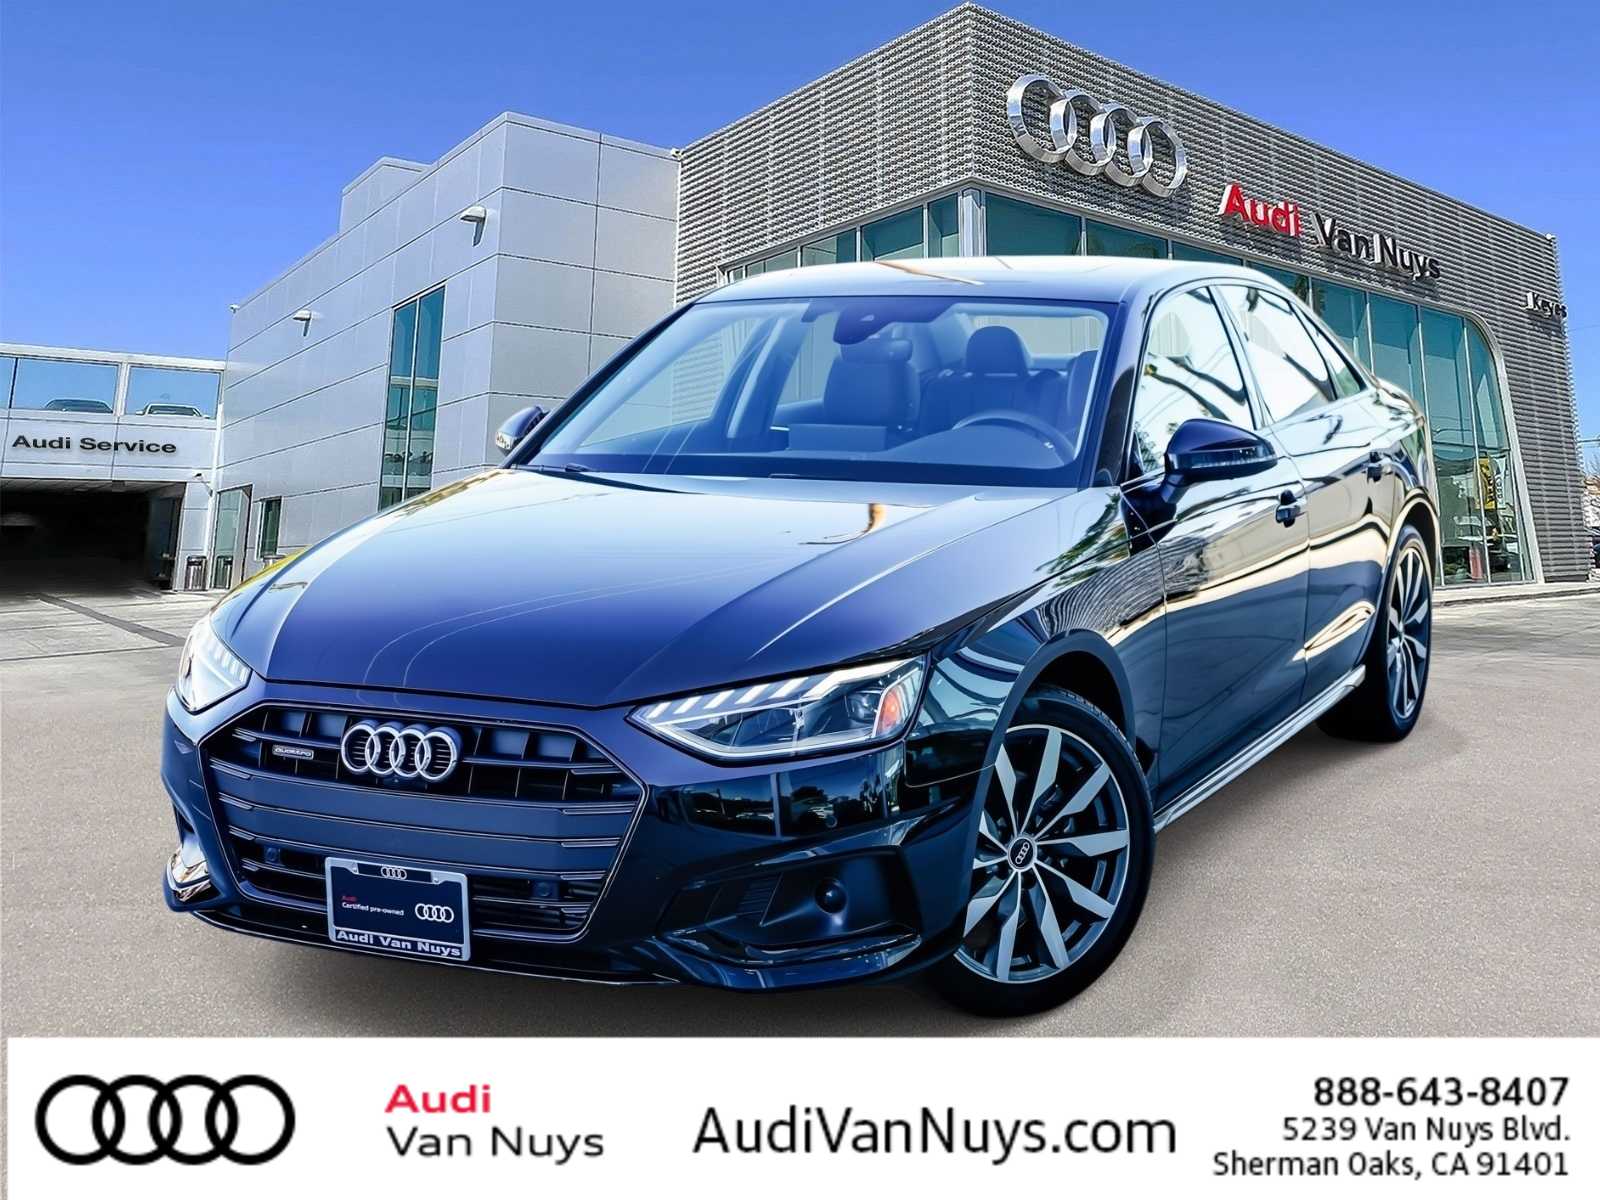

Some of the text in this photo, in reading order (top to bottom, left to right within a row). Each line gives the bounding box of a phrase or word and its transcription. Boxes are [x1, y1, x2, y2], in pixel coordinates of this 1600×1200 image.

[1219, 183, 1441, 281] Audi Van Nuys
[12, 435, 177, 453] Audi Service
[341, 902, 369, 911] Certified
[337, 930, 461, 957] Audi Van Nuys
